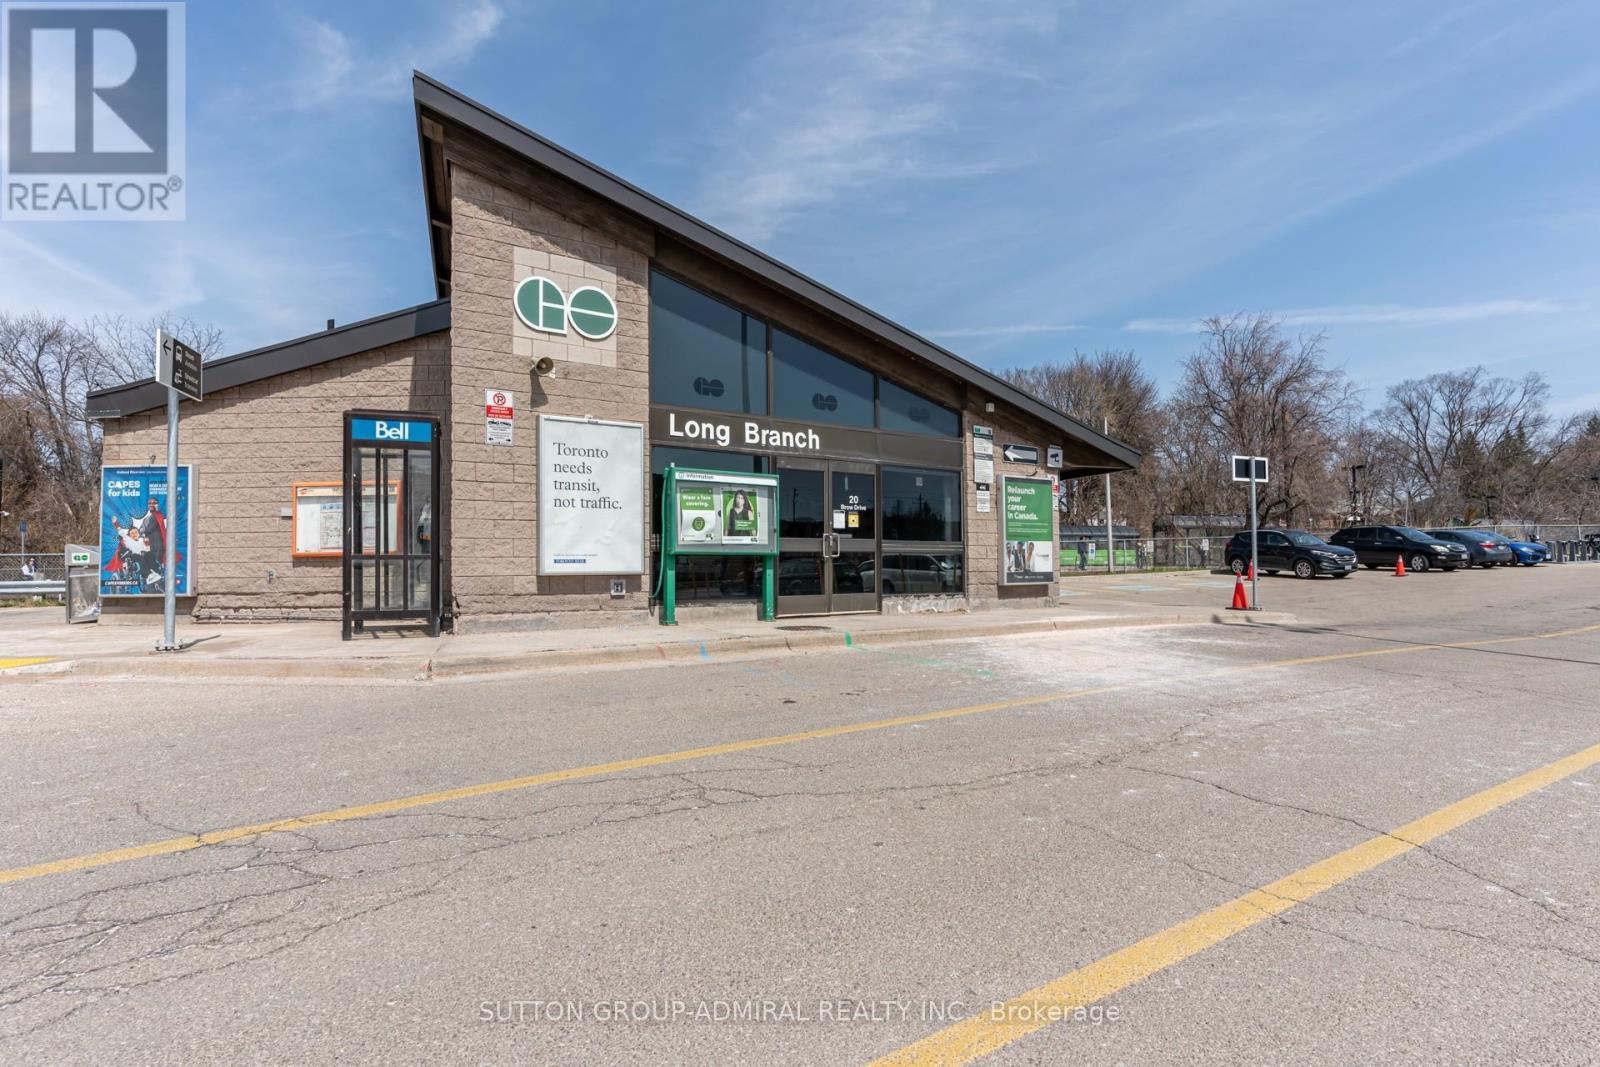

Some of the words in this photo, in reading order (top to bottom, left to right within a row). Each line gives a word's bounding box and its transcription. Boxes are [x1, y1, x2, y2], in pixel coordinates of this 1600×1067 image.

[375, 420, 409, 440] Bell
[669, 413, 730, 447] Long
[744, 422, 820, 450] Branch
[553, 442, 609, 459] Toronto
[553, 462, 592, 475] needs
[108, 480, 140, 489] CAPES
[553, 479, 600, 494] transit,
[1007, 486, 1035, 495] Relaunch
[108, 489, 120, 497] for
[122, 489, 140, 497] kids
[849, 495, 859, 504] 20
[553, 498, 576, 508] not
[580, 496, 622, 510] traffic.
[1008, 511, 1013, 519] in
[1014, 512, 1038, 520] Canada.
